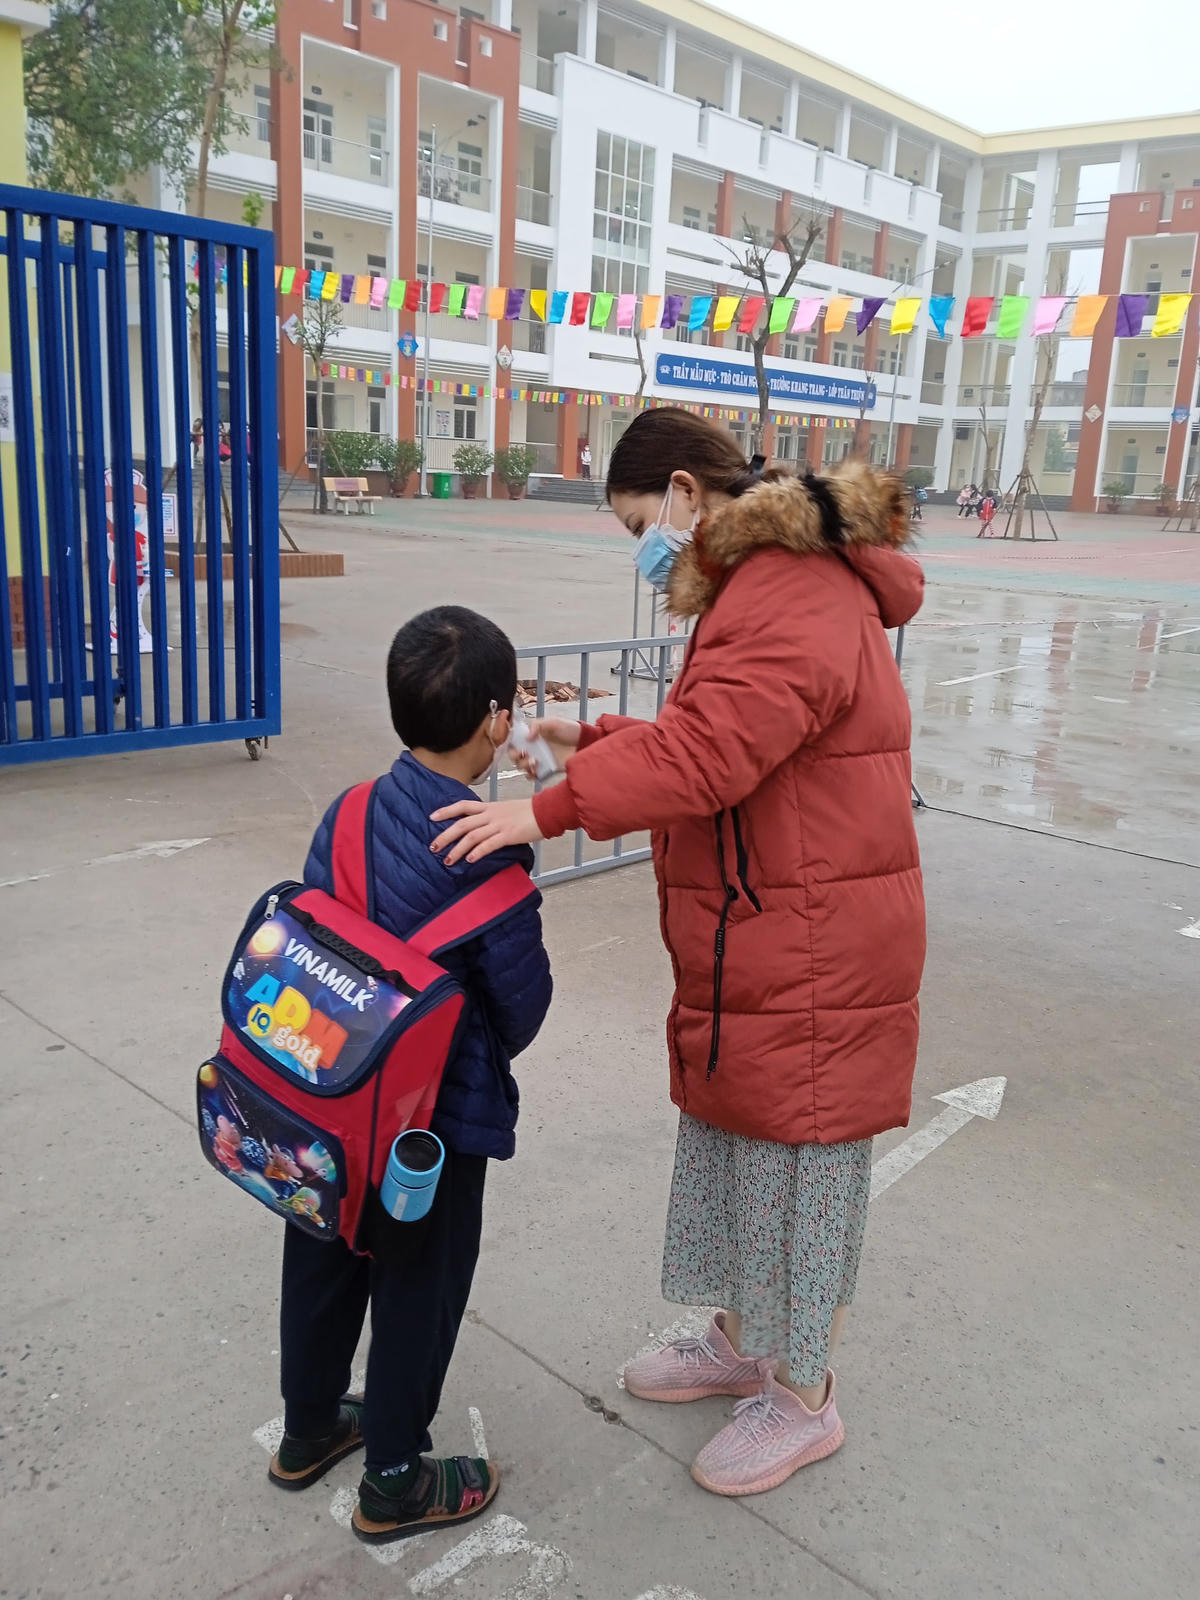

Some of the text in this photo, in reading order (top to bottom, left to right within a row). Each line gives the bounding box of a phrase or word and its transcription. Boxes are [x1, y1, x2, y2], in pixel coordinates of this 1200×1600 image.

[790, 381, 809, 394] KHANG
[809, 383, 826, 396] TRANG
[284, 937, 374, 1012] VINAMILK
[244, 973, 349, 1070] ADM
[251, 1007, 271, 1034] IQ
[272, 1025, 322, 1070] gold
